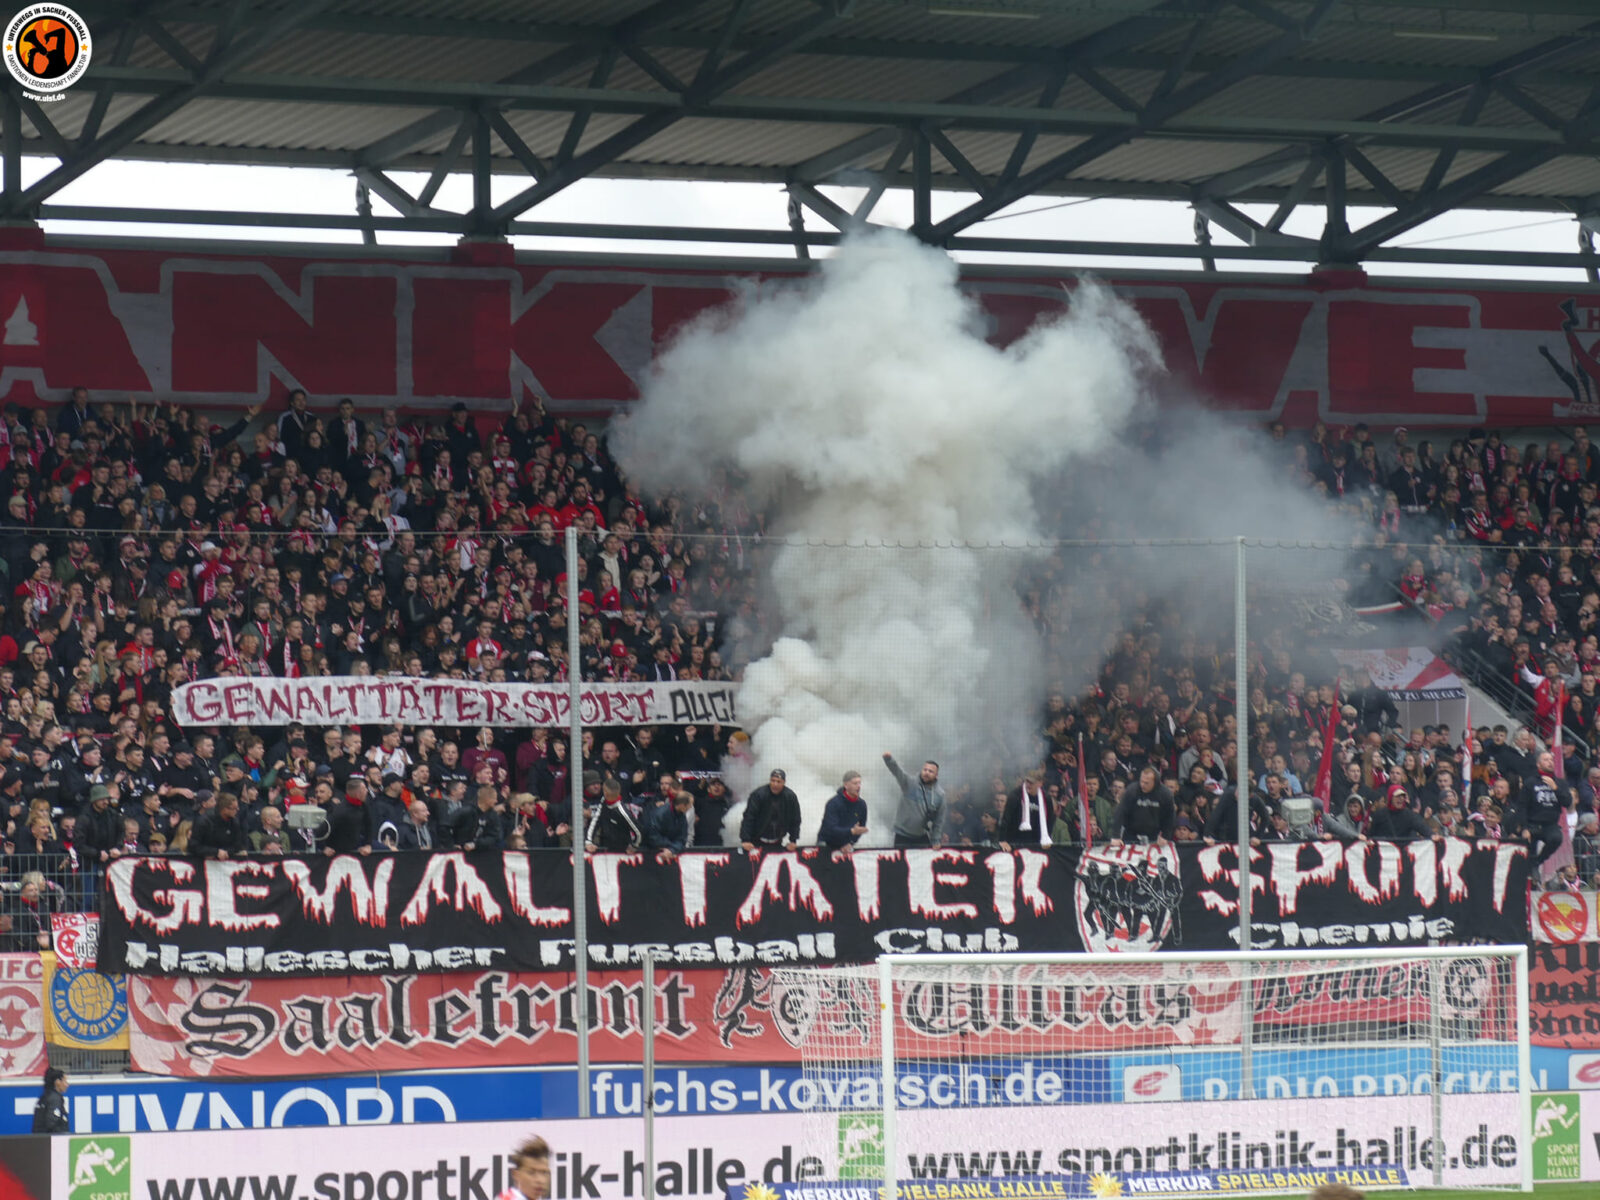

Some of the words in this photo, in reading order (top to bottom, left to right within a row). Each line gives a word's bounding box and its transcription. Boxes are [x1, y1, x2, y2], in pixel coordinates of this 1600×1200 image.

[1198, 839, 1530, 918] SPORT
[873, 926, 1019, 953] Club
[1227, 914, 1456, 950] Chemie
[1546, 1143, 1579, 1156] SPORT
[1546, 1156, 1579, 1167] KLINIK
[1128, 1176, 1212, 1194] MERKUR
[1217, 1171, 1329, 1190] SPIELBANK
[1335, 1166, 1402, 1185] HALLE
[1546, 1167, 1579, 1178] HALLE
[999, 1179, 1067, 1197] HALLE
